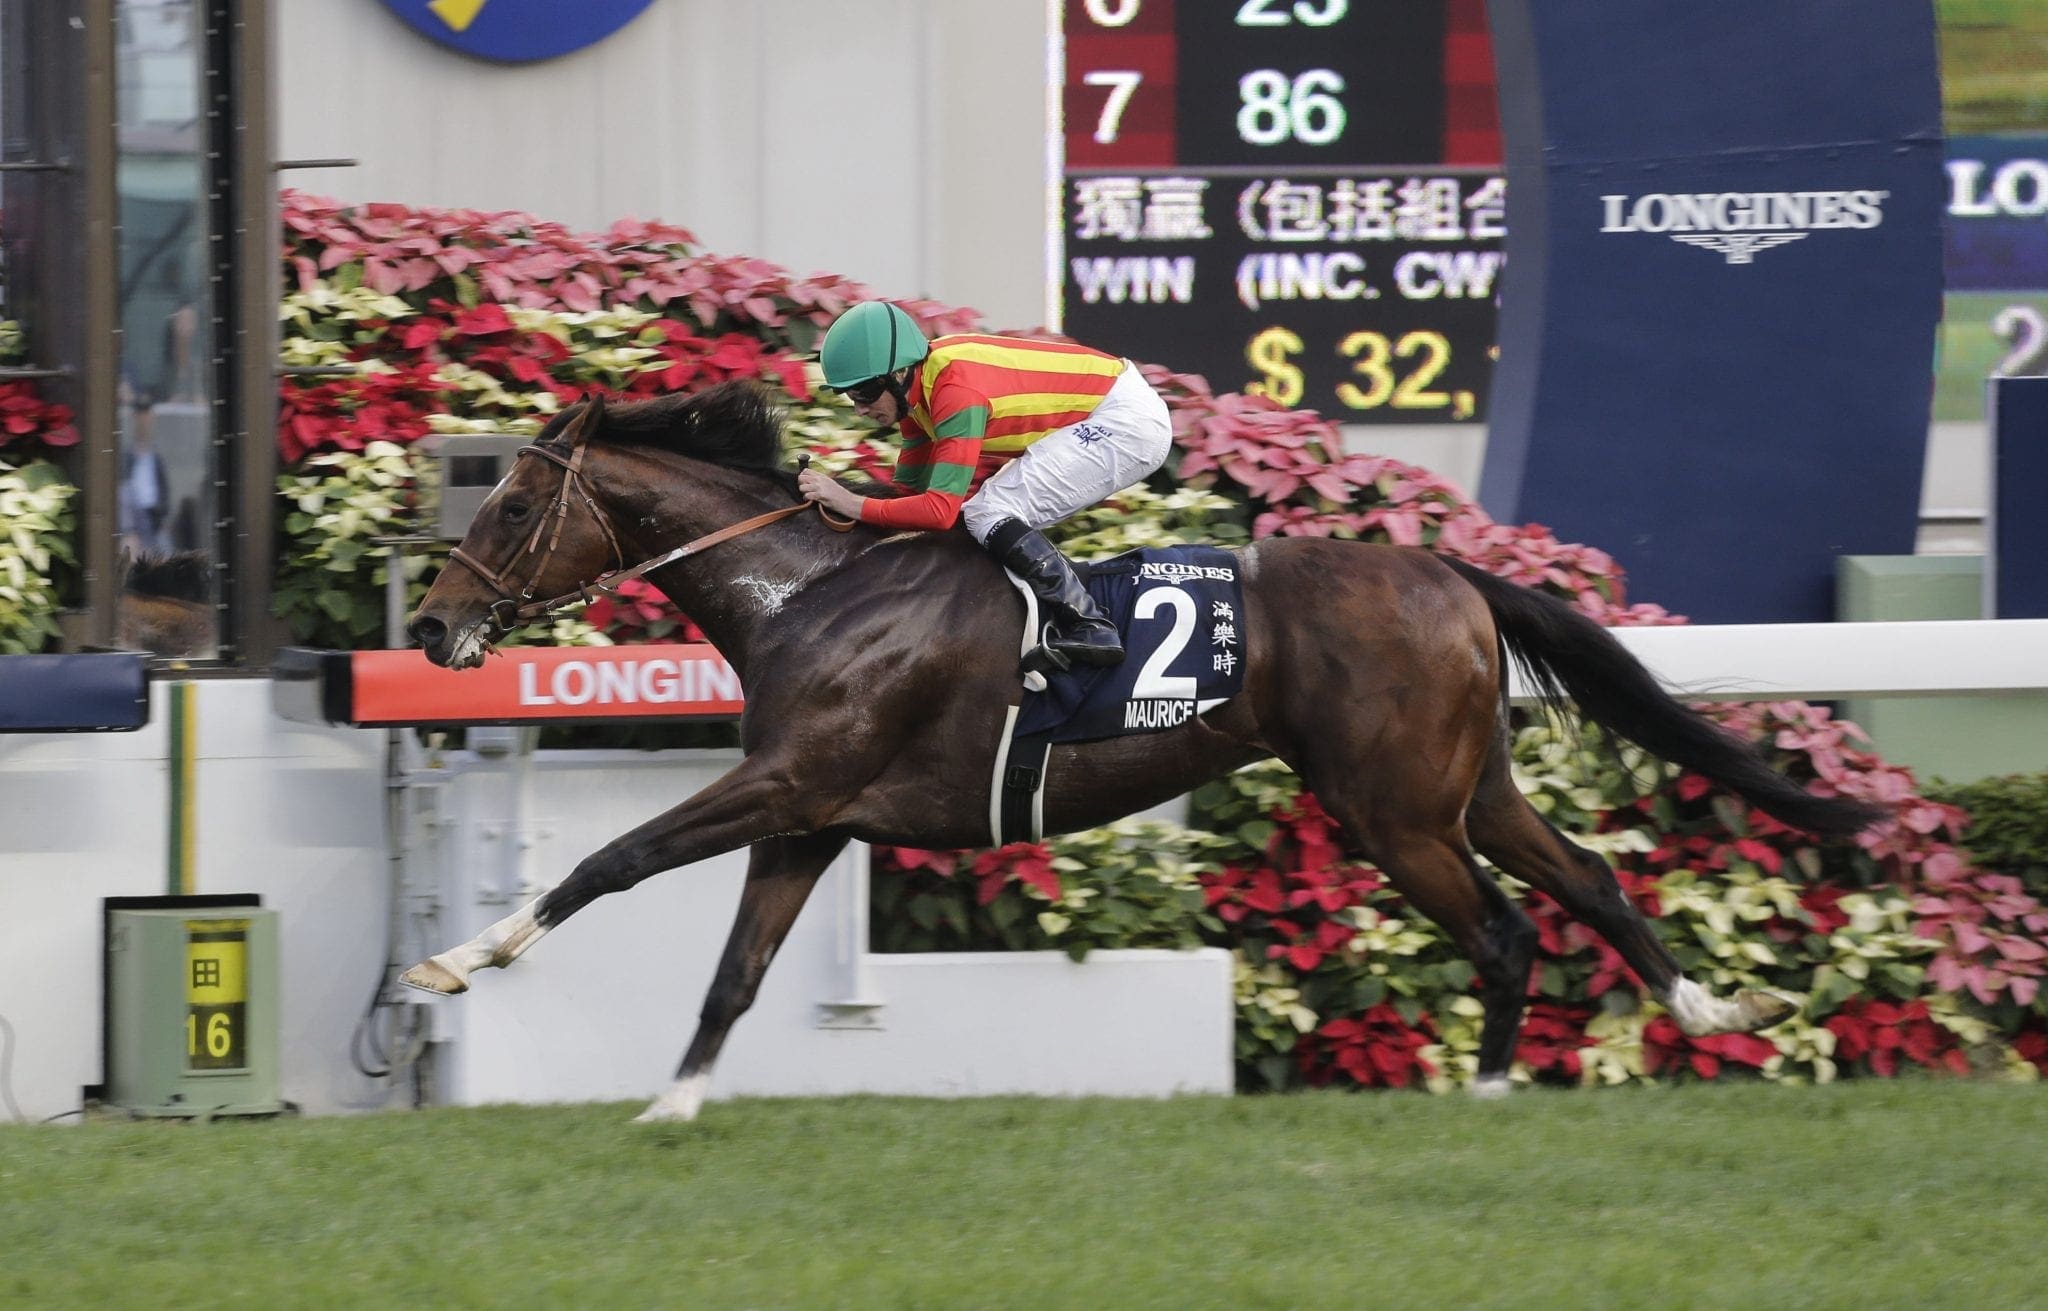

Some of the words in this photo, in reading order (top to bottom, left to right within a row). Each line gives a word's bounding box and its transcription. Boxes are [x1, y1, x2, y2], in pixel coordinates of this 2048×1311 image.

[1083, 70, 1143, 144] 7
[1236, 68, 1347, 145] 86
[1600, 190, 1885, 233] LONGINES
[1946, 159, 2048, 217] LO
[1071, 257, 1195, 304] WIN
[1235, 250, 1380, 311] (INC.
[1394, 250, 1508, 309] CW
[1245, 325, 1305, 407] $
[1336, 329, 1501, 417] 32,
[1131, 585, 1198, 699] 2
[519, 658, 742, 706] LONGIN
[187, 1012, 231, 1058] 16
